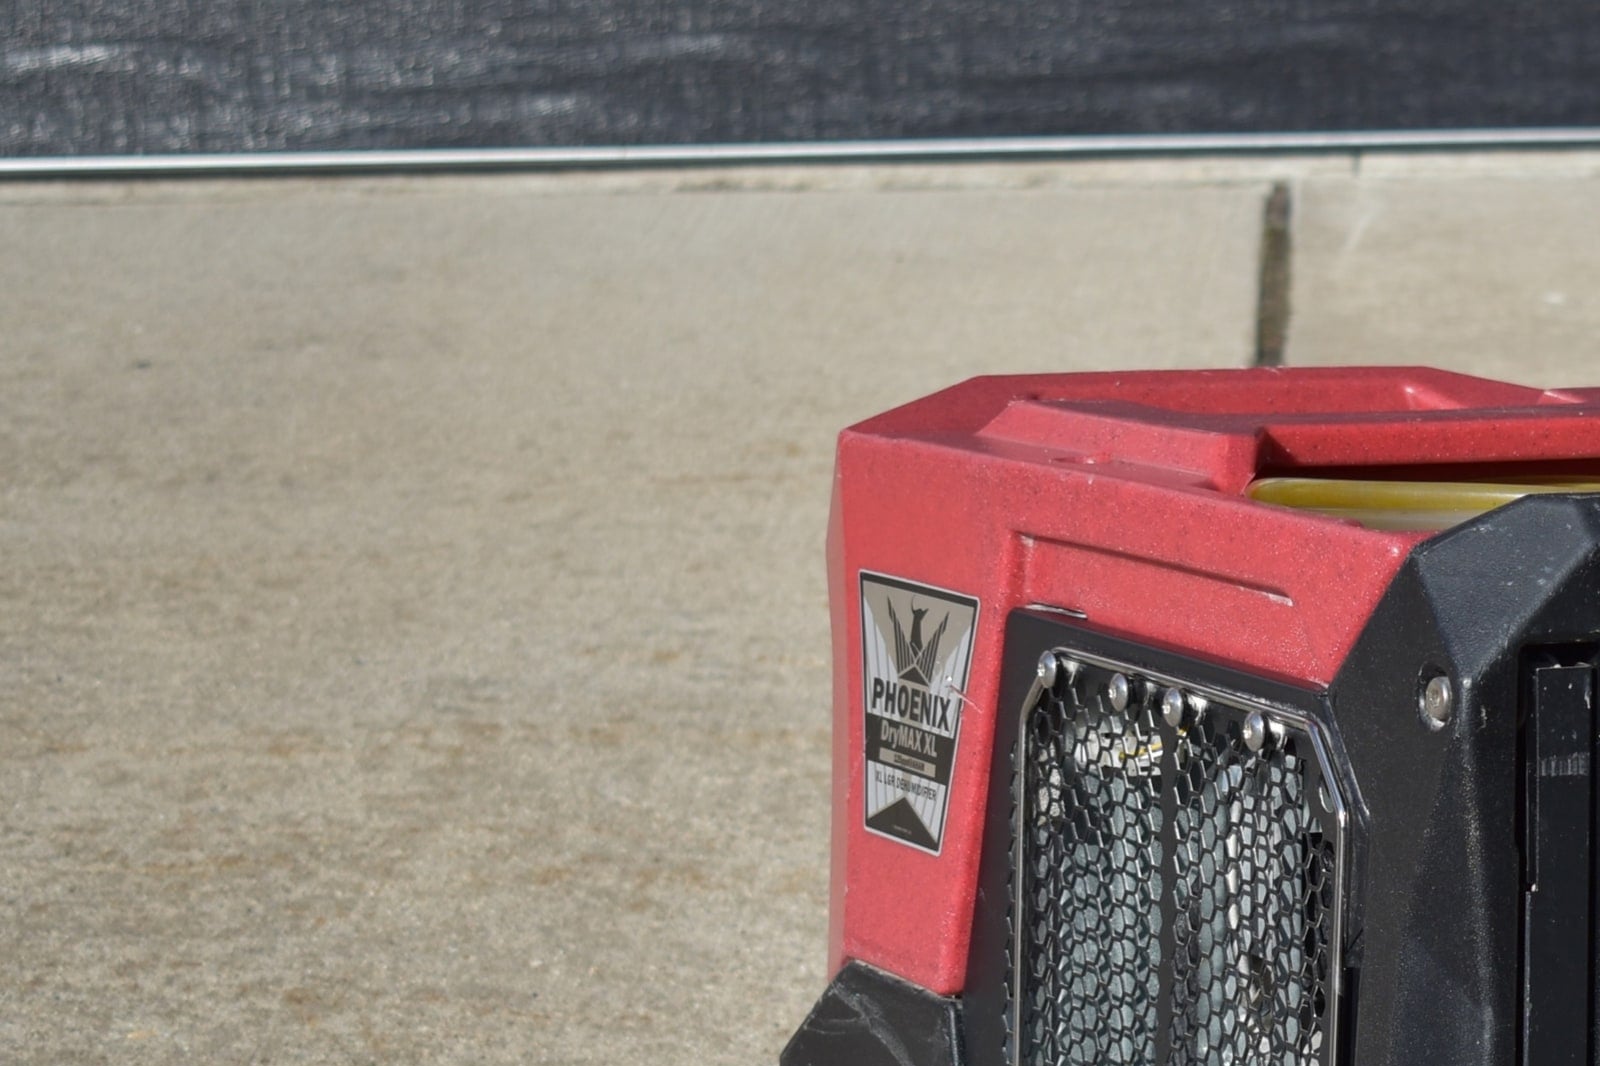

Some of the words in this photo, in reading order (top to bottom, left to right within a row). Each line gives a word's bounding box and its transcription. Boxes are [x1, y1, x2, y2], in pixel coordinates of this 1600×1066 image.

[872, 677, 951, 732] PHOENIX
[881, 719, 921, 752] DryMAX
[923, 735, 937, 758] XL
